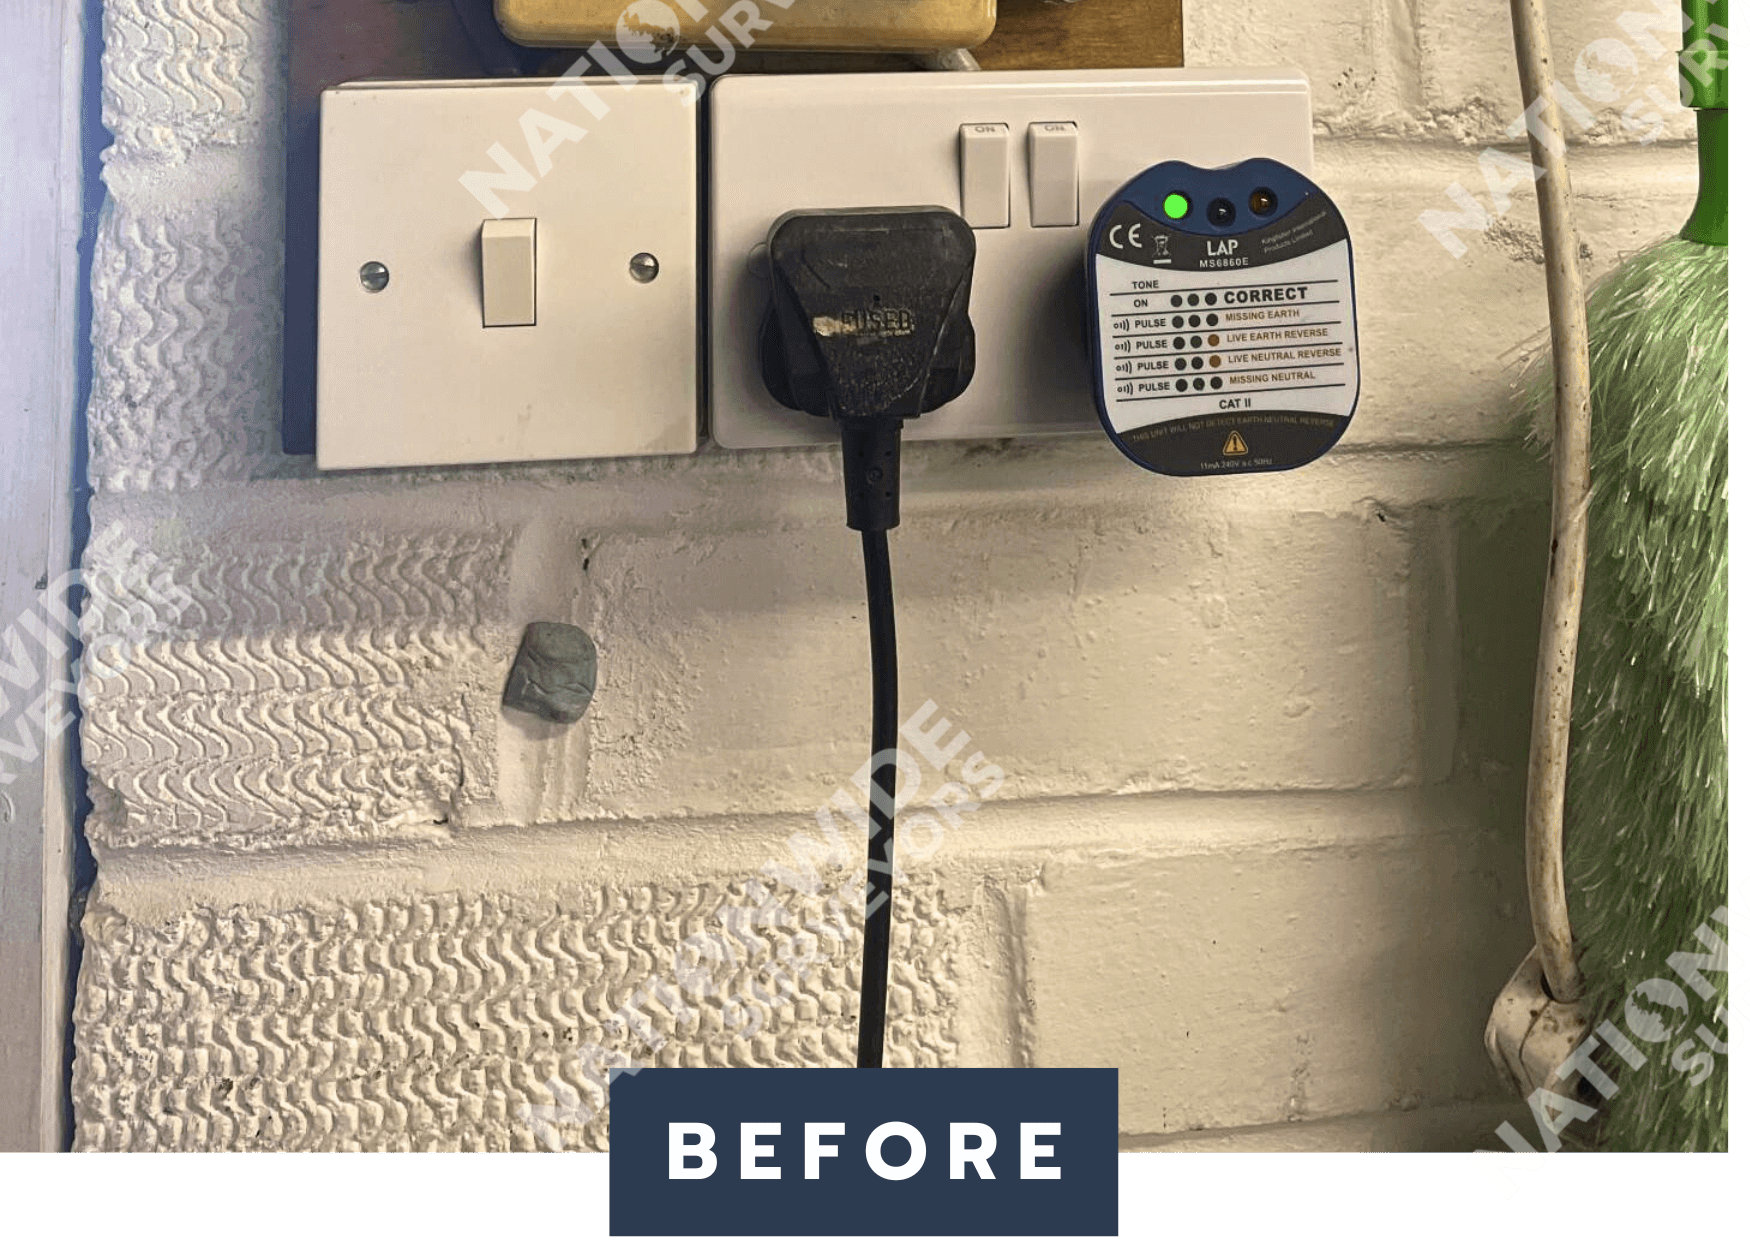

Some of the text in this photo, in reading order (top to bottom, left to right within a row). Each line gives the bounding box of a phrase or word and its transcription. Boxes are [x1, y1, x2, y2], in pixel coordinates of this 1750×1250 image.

[1207, 240, 1238, 256] LAP
[1132, 279, 1159, 290] TONE
[1224, 287, 1308, 305] CORRECT
[1134, 298, 1148, 308] ON
[1225, 309, 1300, 322] MISSING EARTH
[1134, 318, 1167, 329] PULSE
[1227, 327, 1328, 343] LIVE EARTH REVERSE
[1136, 339, 1168, 349] PULSE
[1228, 348, 1341, 364] LIVE NEUTRAL REVERSE
[1137, 360, 1169, 371] PULSE
[1230, 371, 1316, 385] MISSING NEUTRAL
[1138, 381, 1170, 392] PULSE
[1219, 399, 1242, 410] CAT
